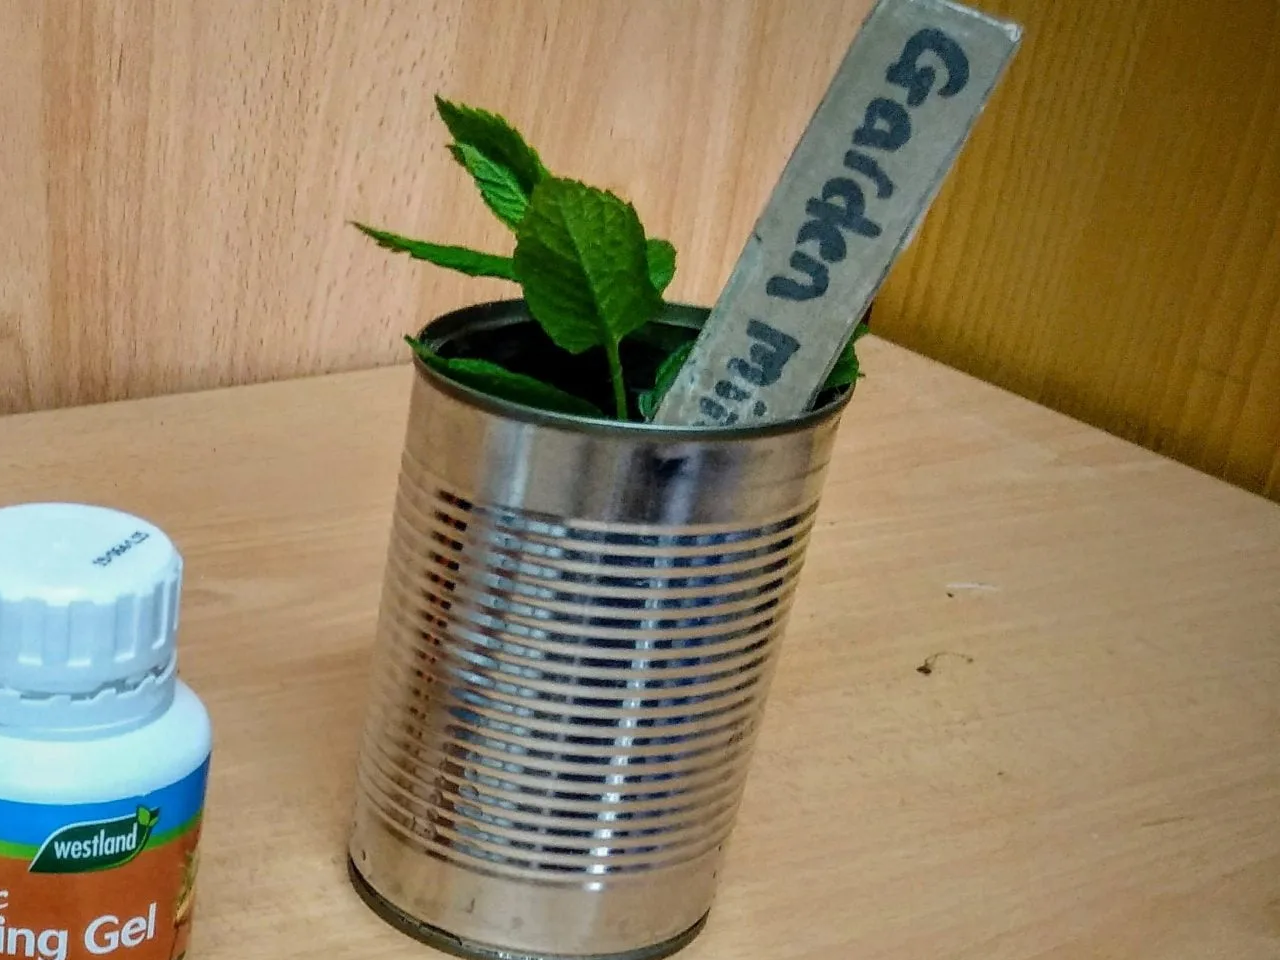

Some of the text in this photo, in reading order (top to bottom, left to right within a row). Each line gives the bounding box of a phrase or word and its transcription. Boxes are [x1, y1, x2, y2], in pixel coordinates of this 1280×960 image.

[765, 28, 970, 301] Garden
[53, 822, 138, 859] westland
[84, 901, 157, 955] Gel
